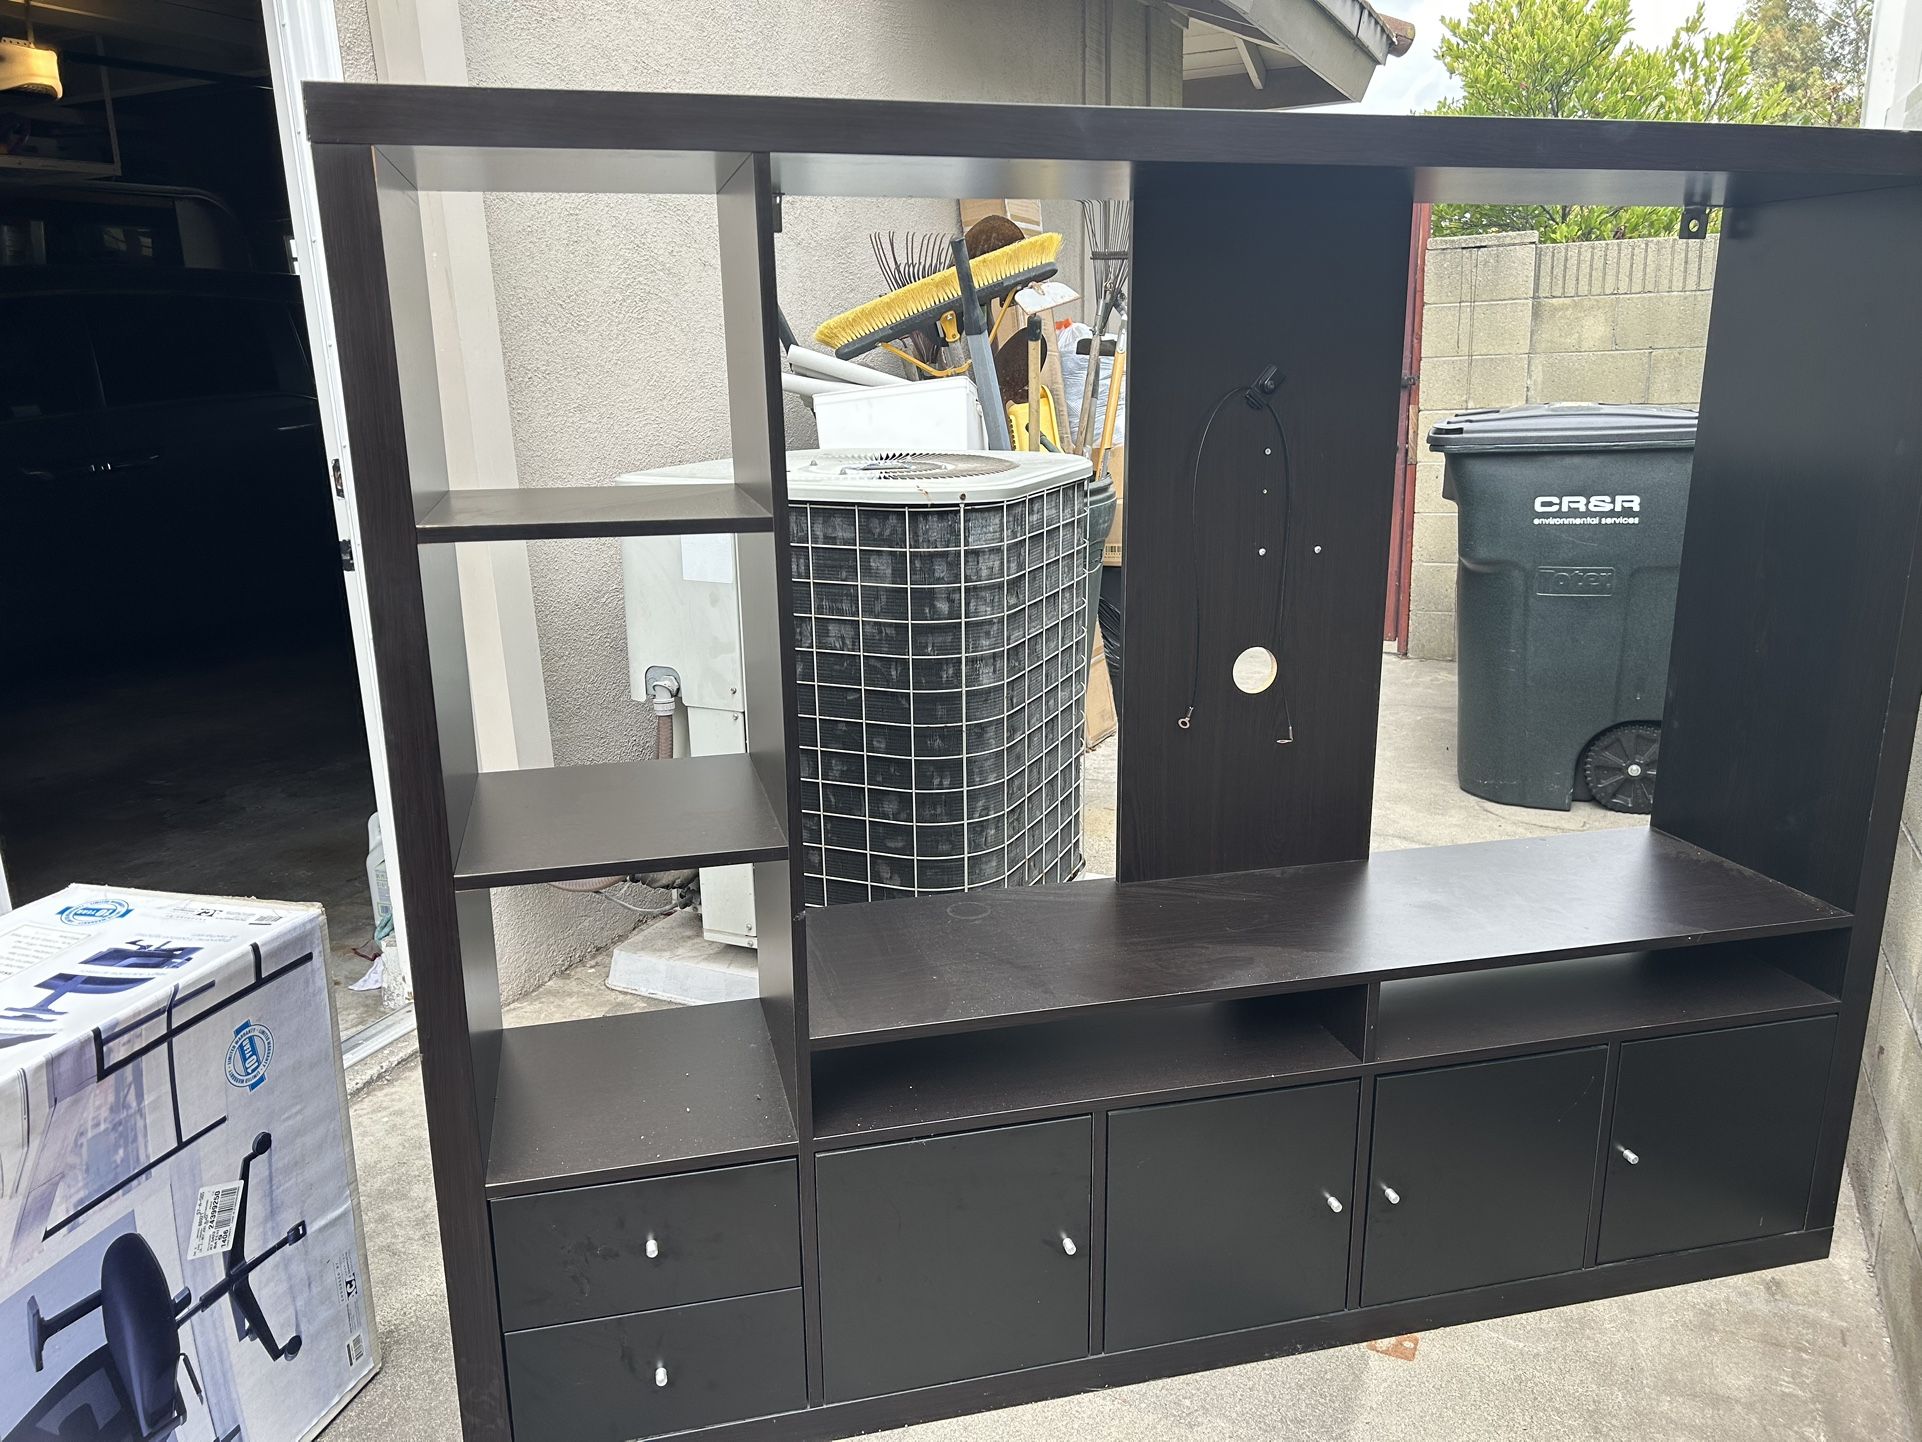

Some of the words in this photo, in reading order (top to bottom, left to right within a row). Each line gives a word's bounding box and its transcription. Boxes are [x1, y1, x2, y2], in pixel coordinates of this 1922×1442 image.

[1534, 495, 1641, 513] CR&R
[1533, 516, 1599, 525] environmental
[1601, 516, 1639, 525] services
[94, 909, 114, 918] 10
[234, 1028, 256, 1045] WARRANTY
[242, 1038, 254, 1058] YEAR
[244, 1054, 259, 1074] 10
[208, 1190, 221, 1230] 24399250
